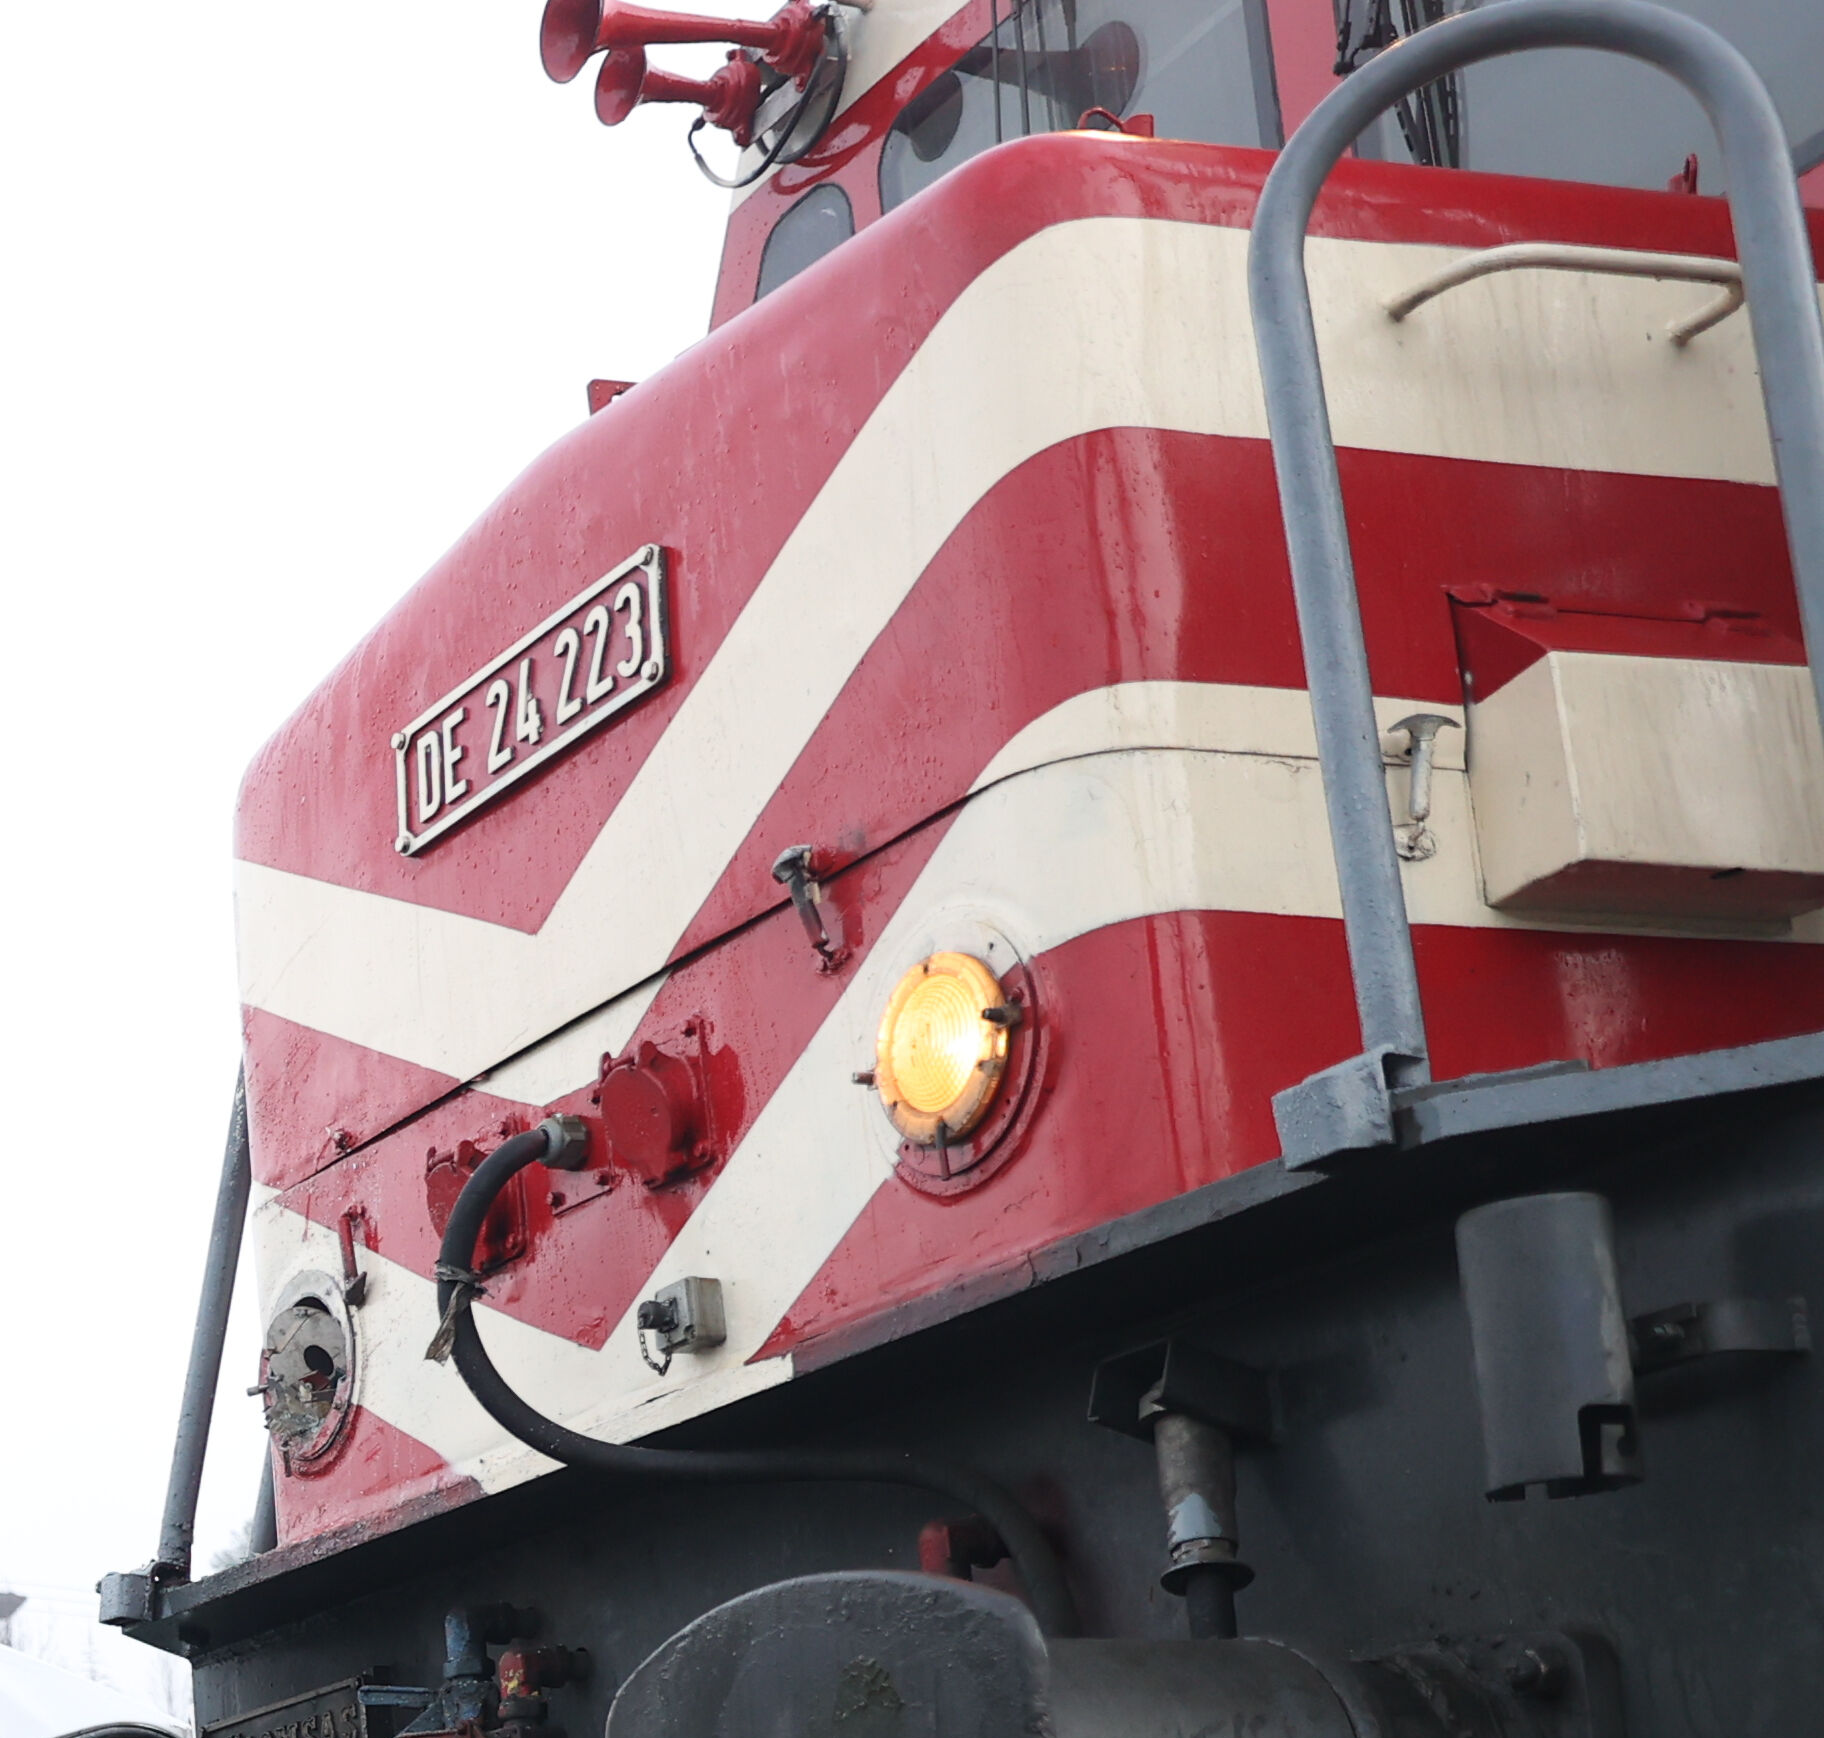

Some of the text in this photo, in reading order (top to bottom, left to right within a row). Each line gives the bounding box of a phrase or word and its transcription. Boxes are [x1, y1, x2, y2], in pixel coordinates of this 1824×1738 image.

[417, 581, 644, 823] DE 24 223
